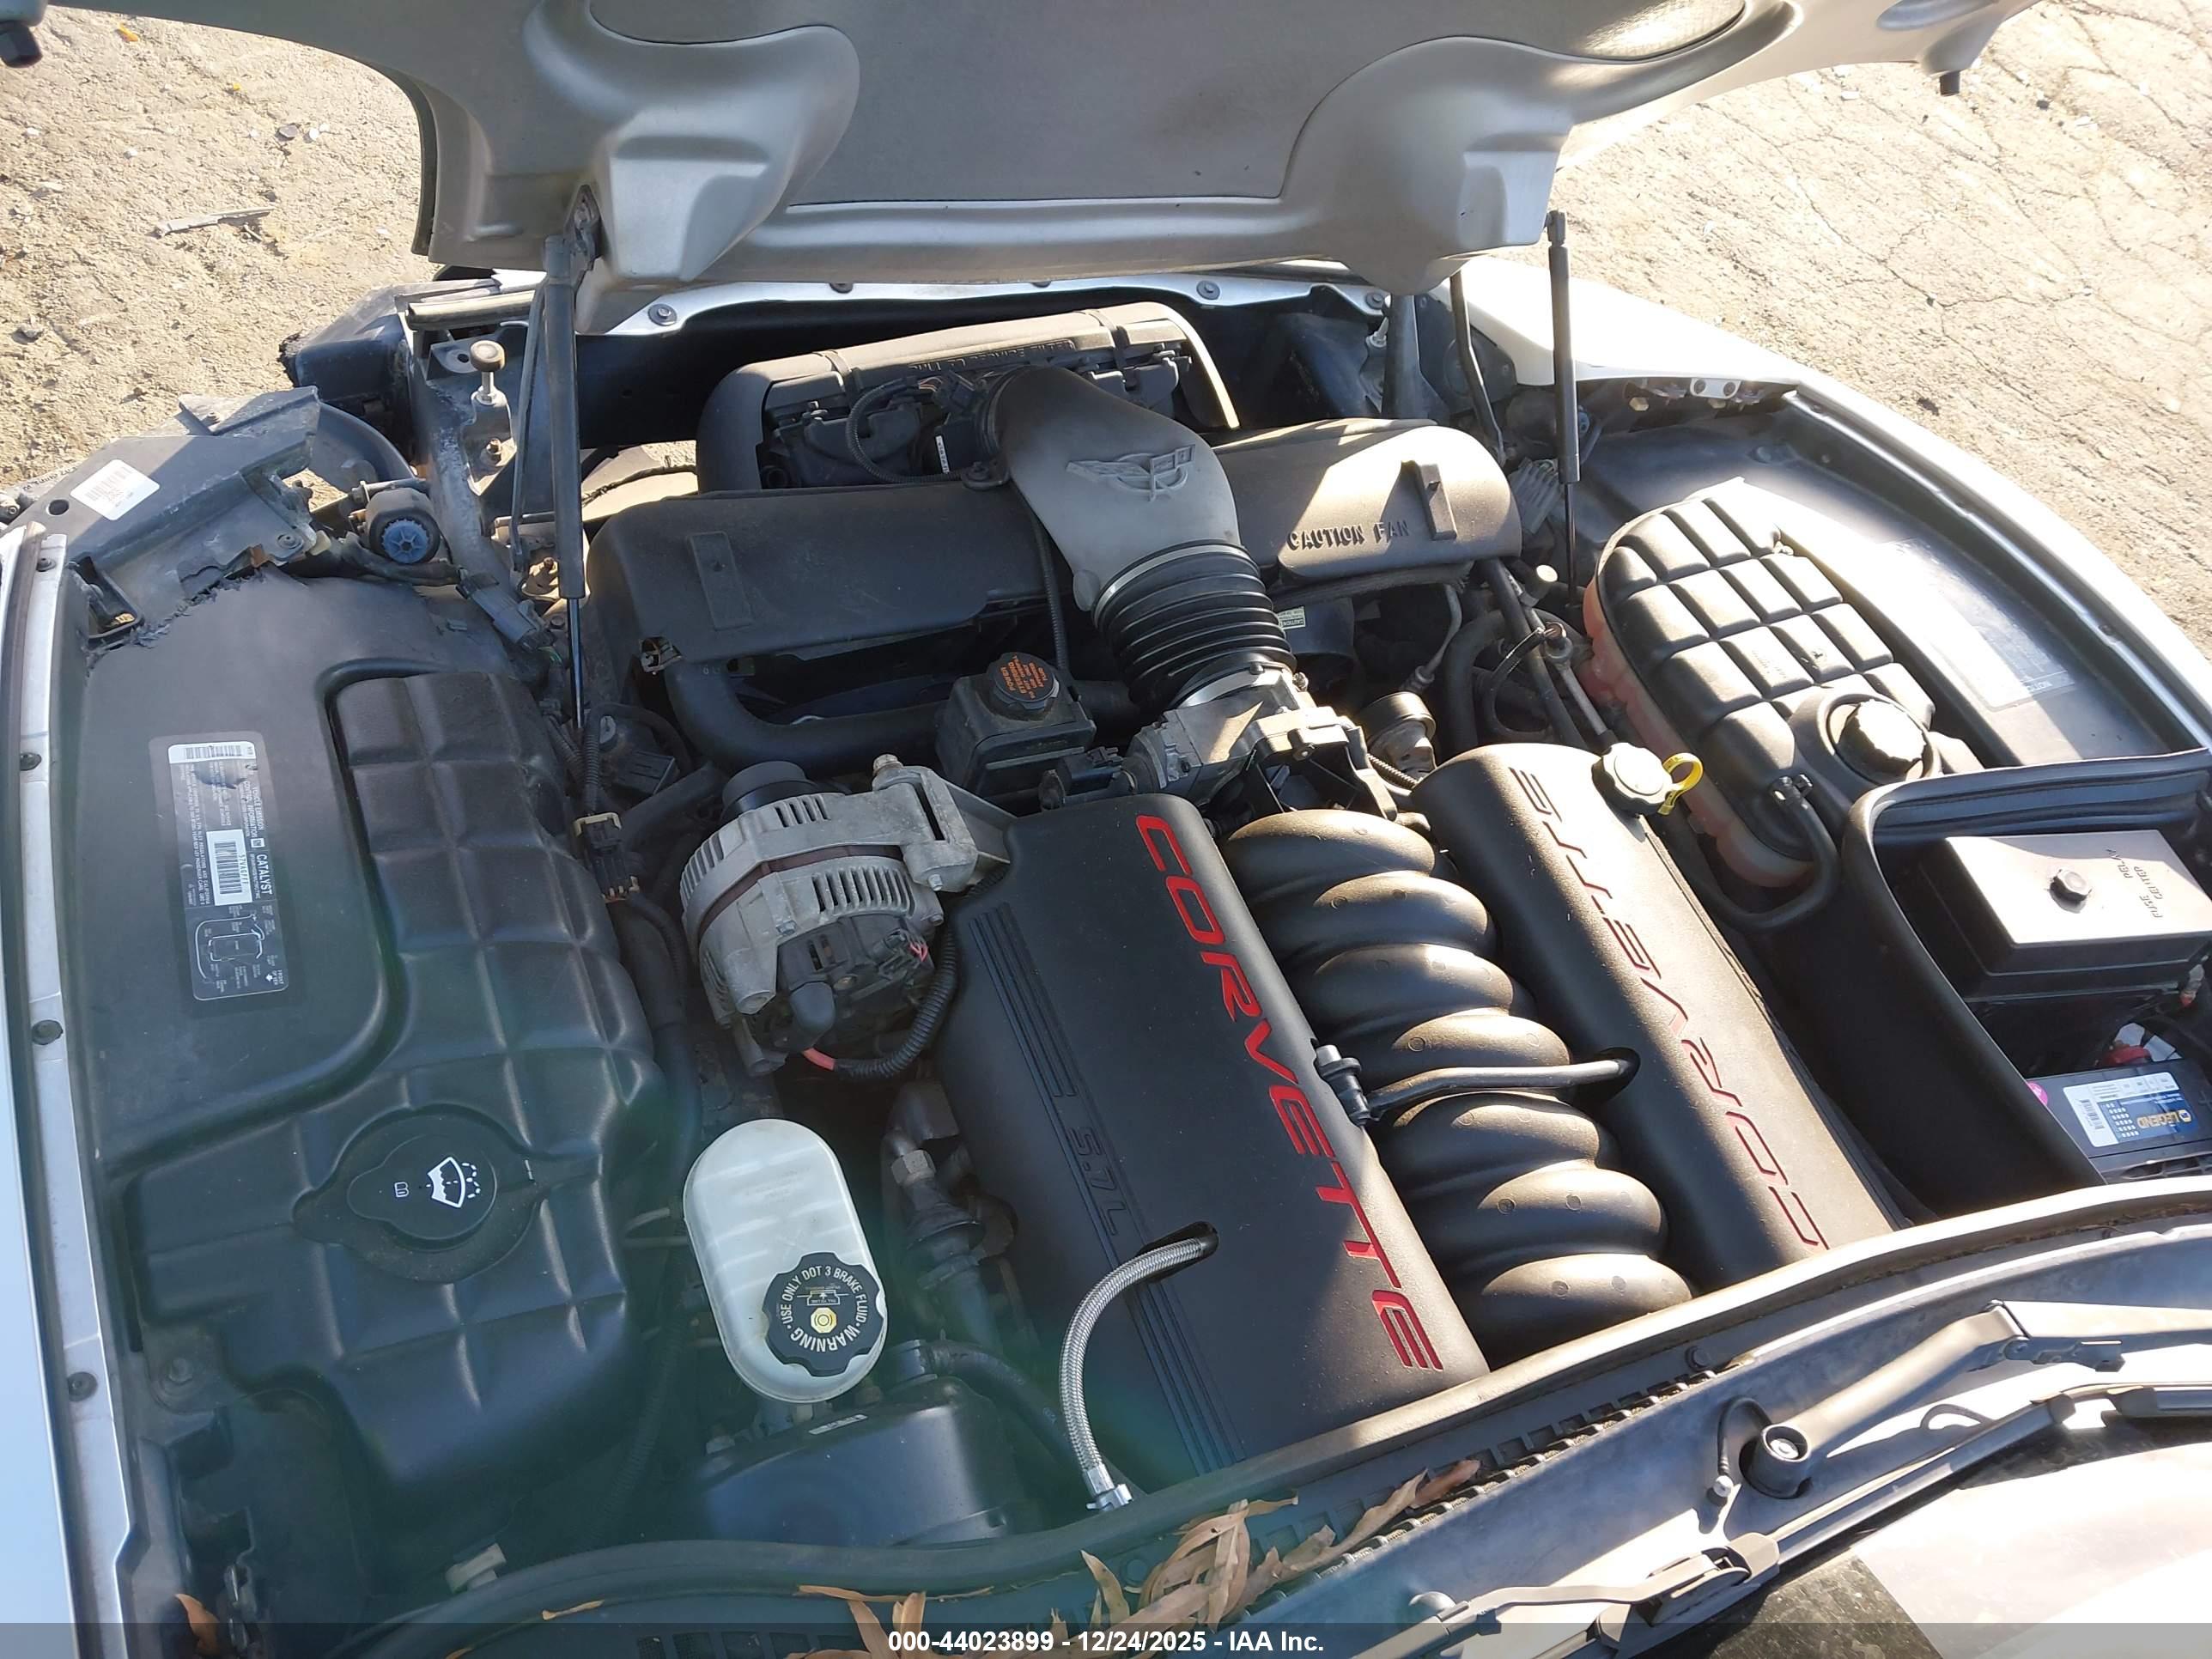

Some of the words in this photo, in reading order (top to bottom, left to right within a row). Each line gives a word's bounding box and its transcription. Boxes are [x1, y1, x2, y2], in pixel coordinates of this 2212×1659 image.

[1286, 525, 1364, 550] CAUTION
[1373, 520, 1409, 543] FAN
[1000, 666, 1016, 691] POWER
[1007, 661, 1027, 694] STEERING
[257, 854, 273, 895] CATALYST
[1509, 767, 1829, 1250] CORVETTE
[1136, 815, 1443, 1372] CORVETTE
[2136, 1110, 2179, 1129] LEGEND
[1067, 1127, 1127, 1236] 5.7L
[801, 1265, 823, 1280] DOT
[824, 1266, 832, 1277] 3
[833, 1267, 862, 1294] BRAKE
[781, 1275, 802, 1302] ONLY
[781, 1304, 793, 1324] USE
[855, 1293, 869, 1323] FLUID
[790, 1324, 860, 1352] WARNING
